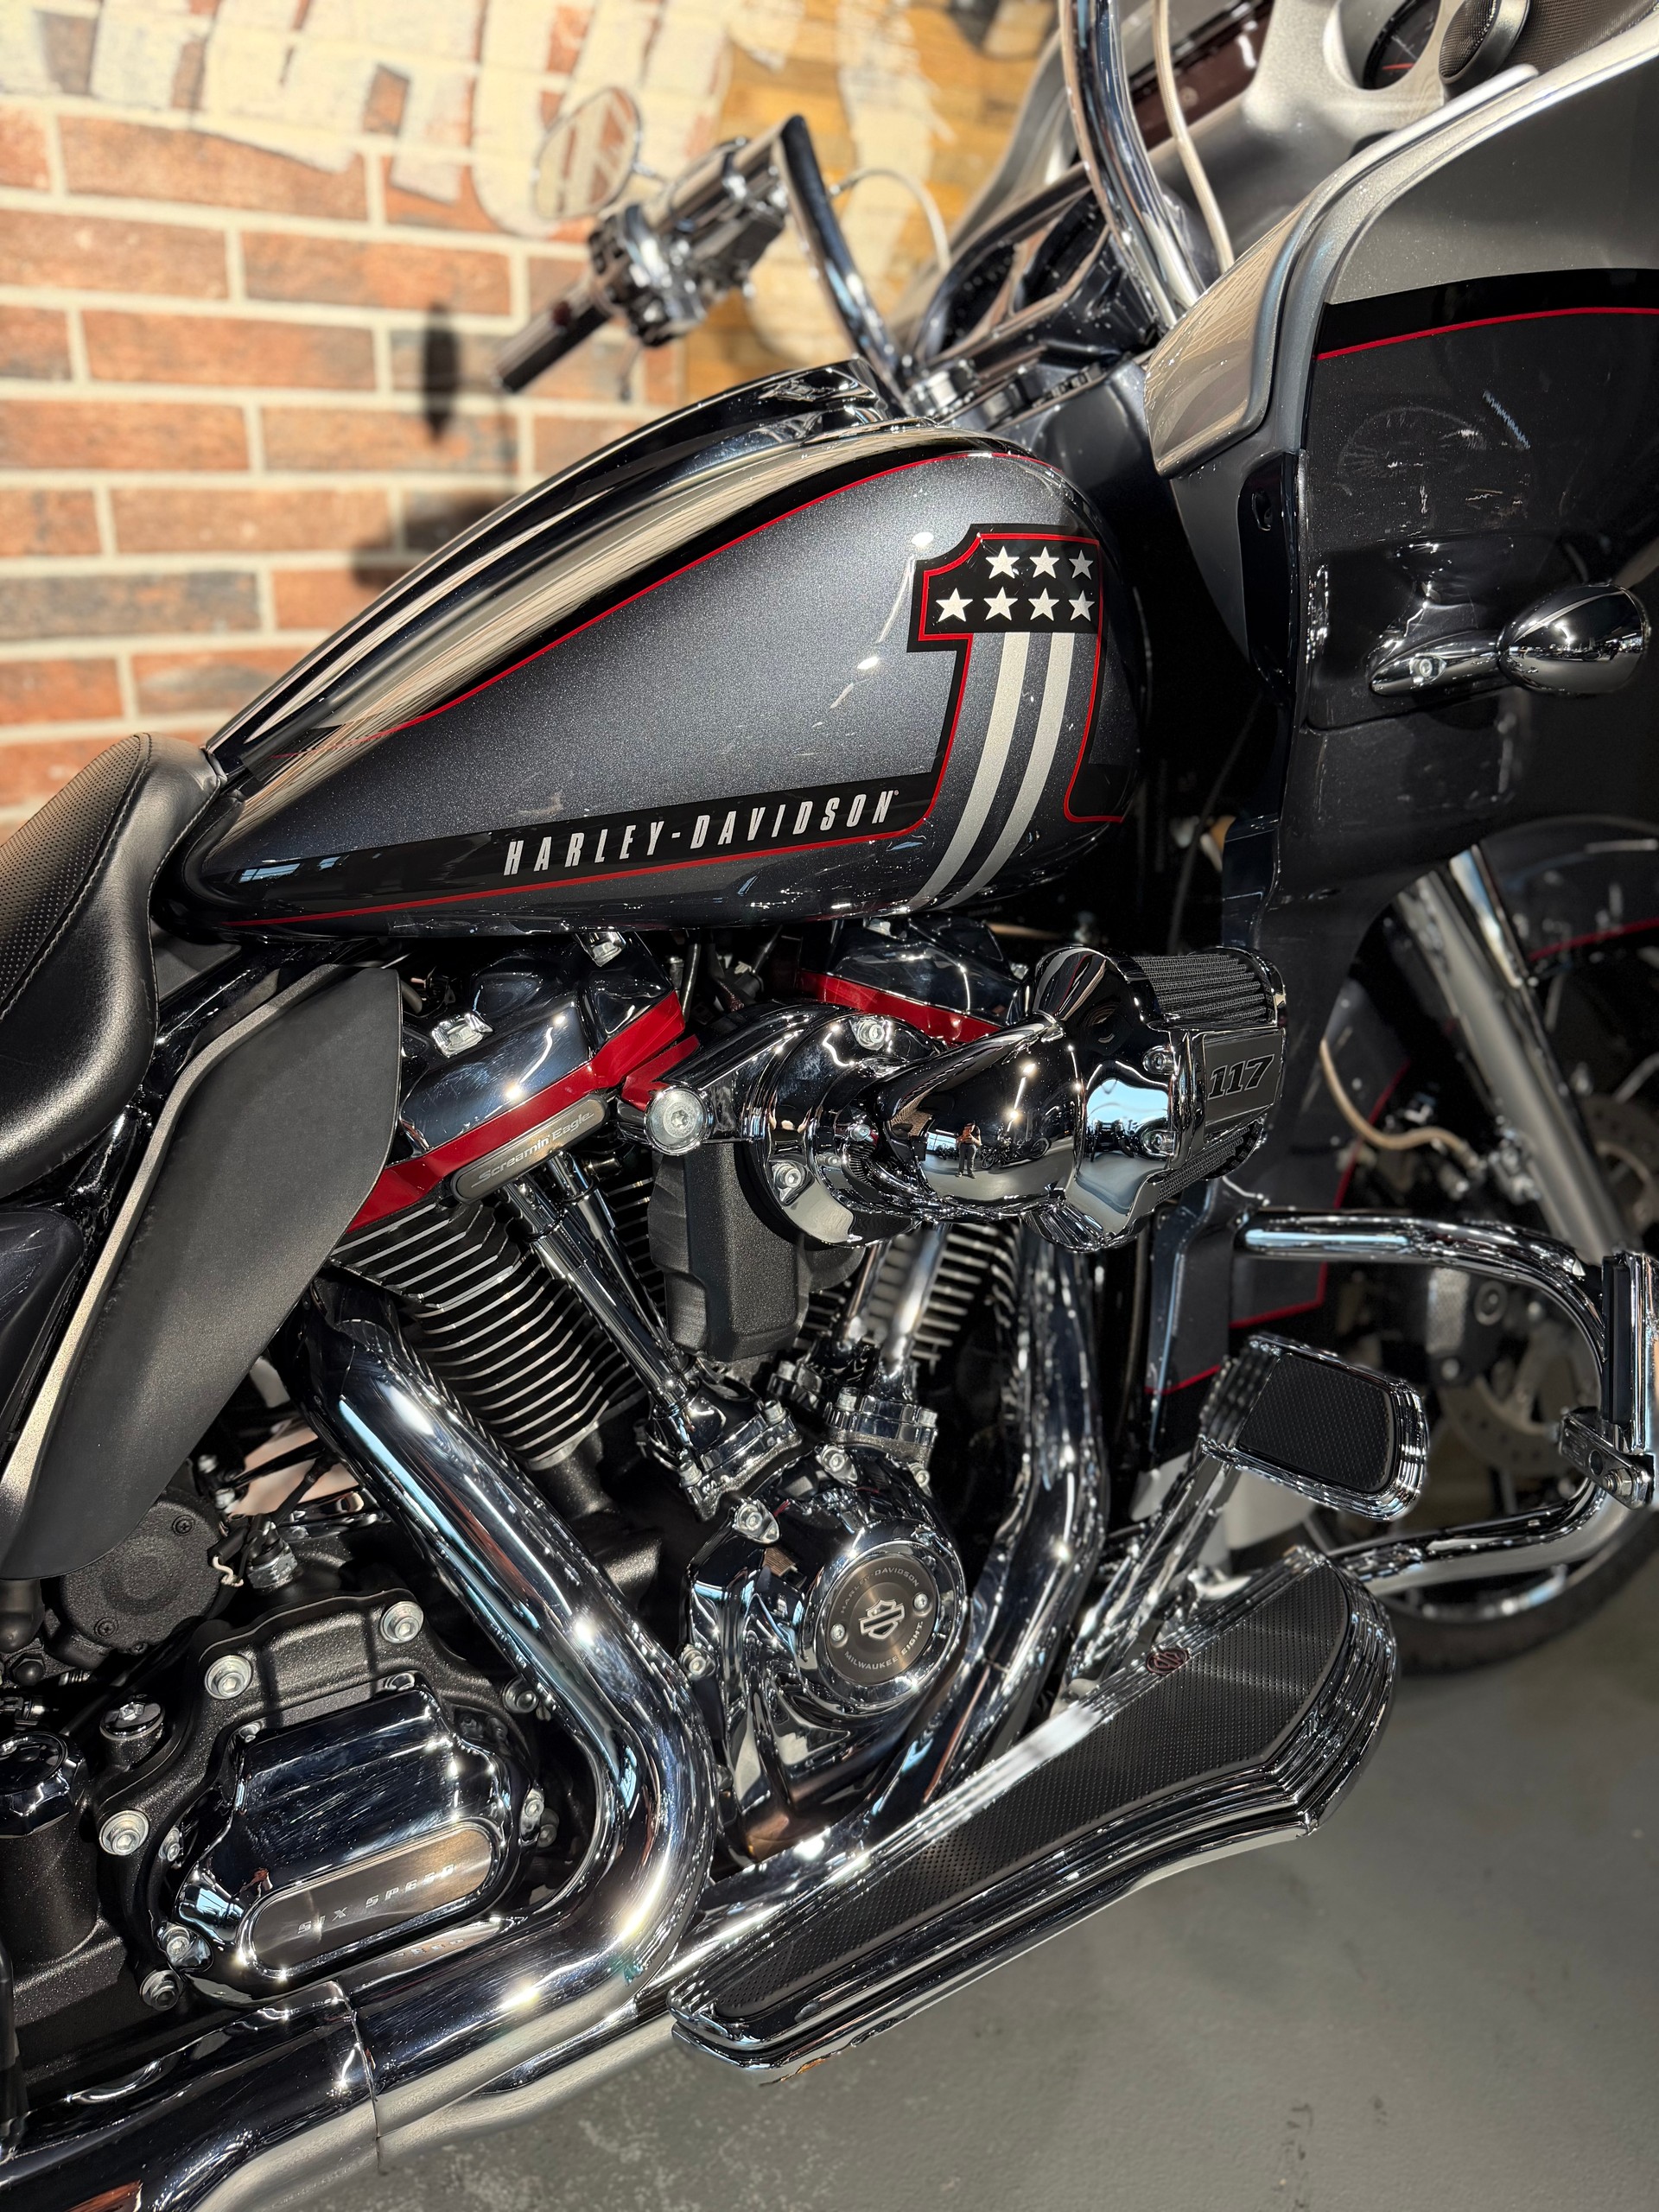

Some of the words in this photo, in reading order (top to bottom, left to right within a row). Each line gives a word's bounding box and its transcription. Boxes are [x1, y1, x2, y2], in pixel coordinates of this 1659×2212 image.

[503, 789, 899, 876] HARLEY-DAVIDSON
[1206, 1053, 1275, 1101] 117
[551, 1112, 595, 1141] Eagle
[296, 1906, 348, 1936] SIX
[365, 1864, 457, 1908] SPEED
